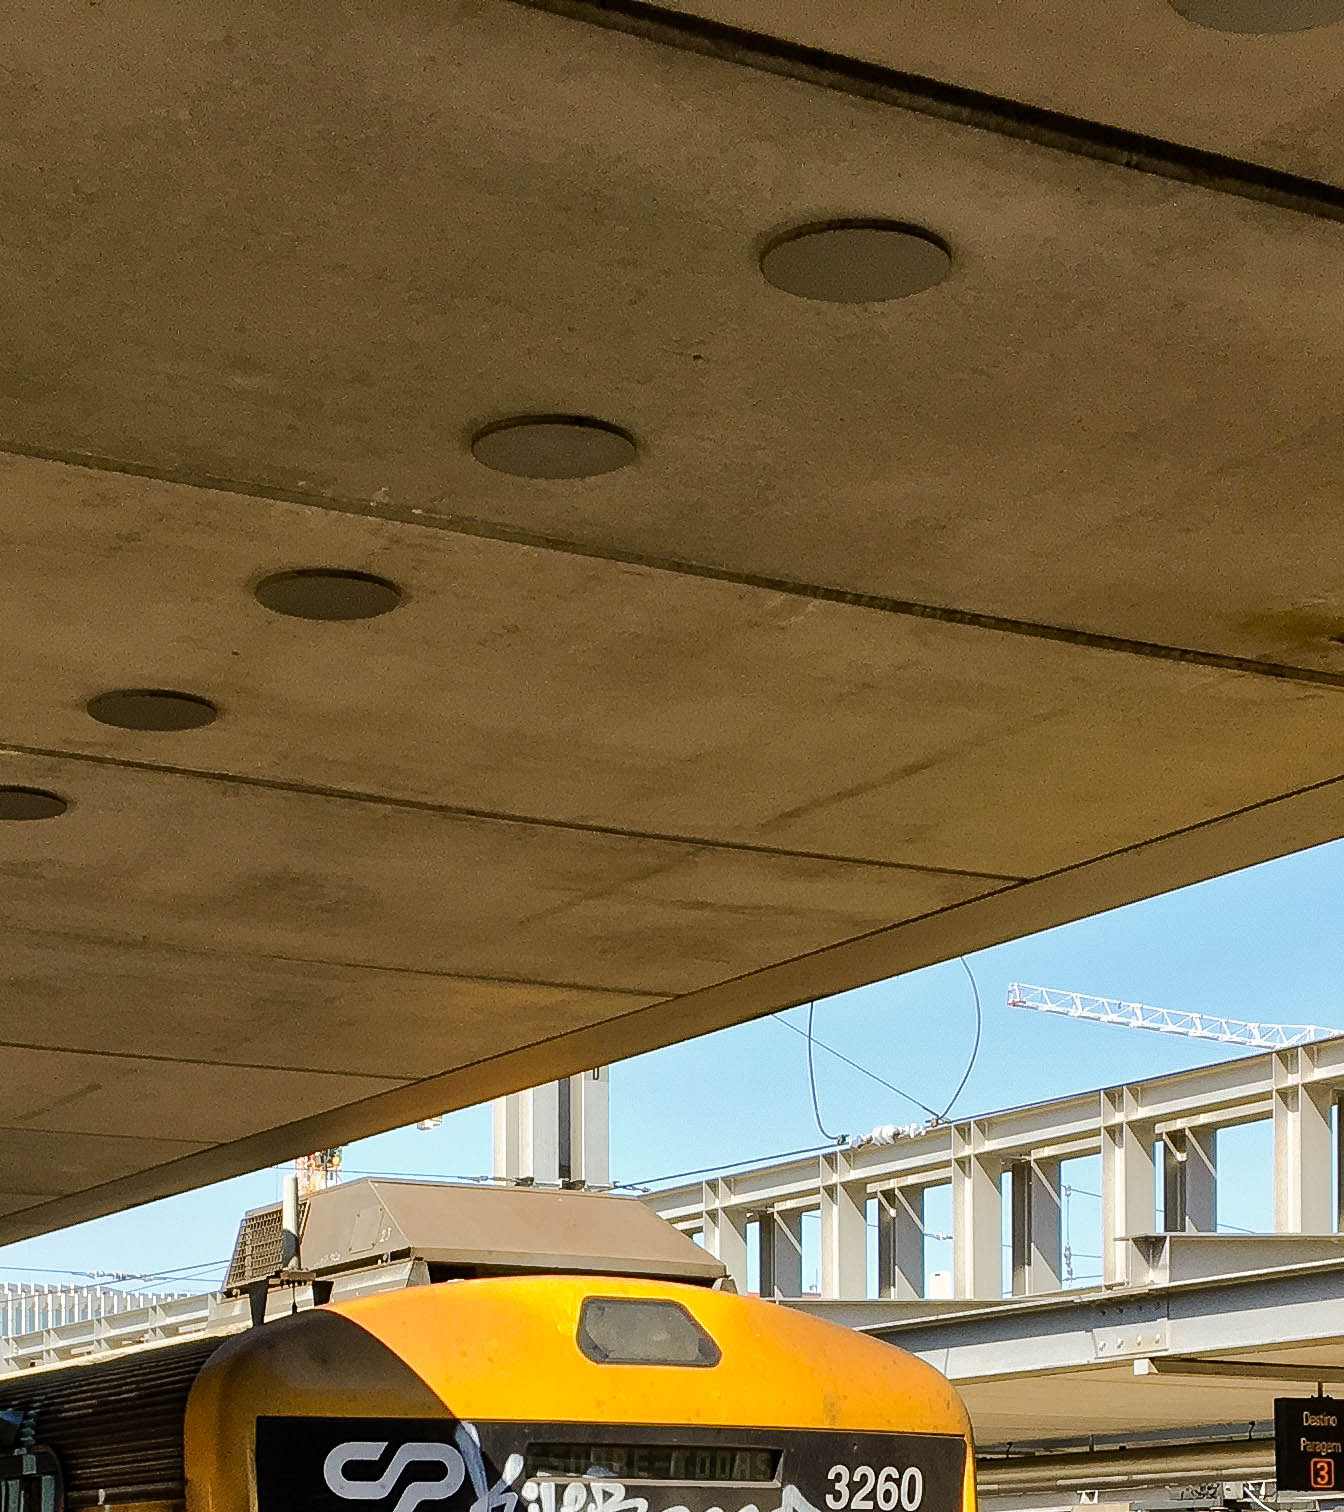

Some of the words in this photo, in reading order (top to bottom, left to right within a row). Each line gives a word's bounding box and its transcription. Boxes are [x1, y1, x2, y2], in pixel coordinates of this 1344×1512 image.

[1303, 1411, 1338, 1427] Destino
[1300, 1437, 1342, 1454] Paragem
[1316, 1462, 1330, 1485] 3
[825, 1463, 923, 1512] 3260
